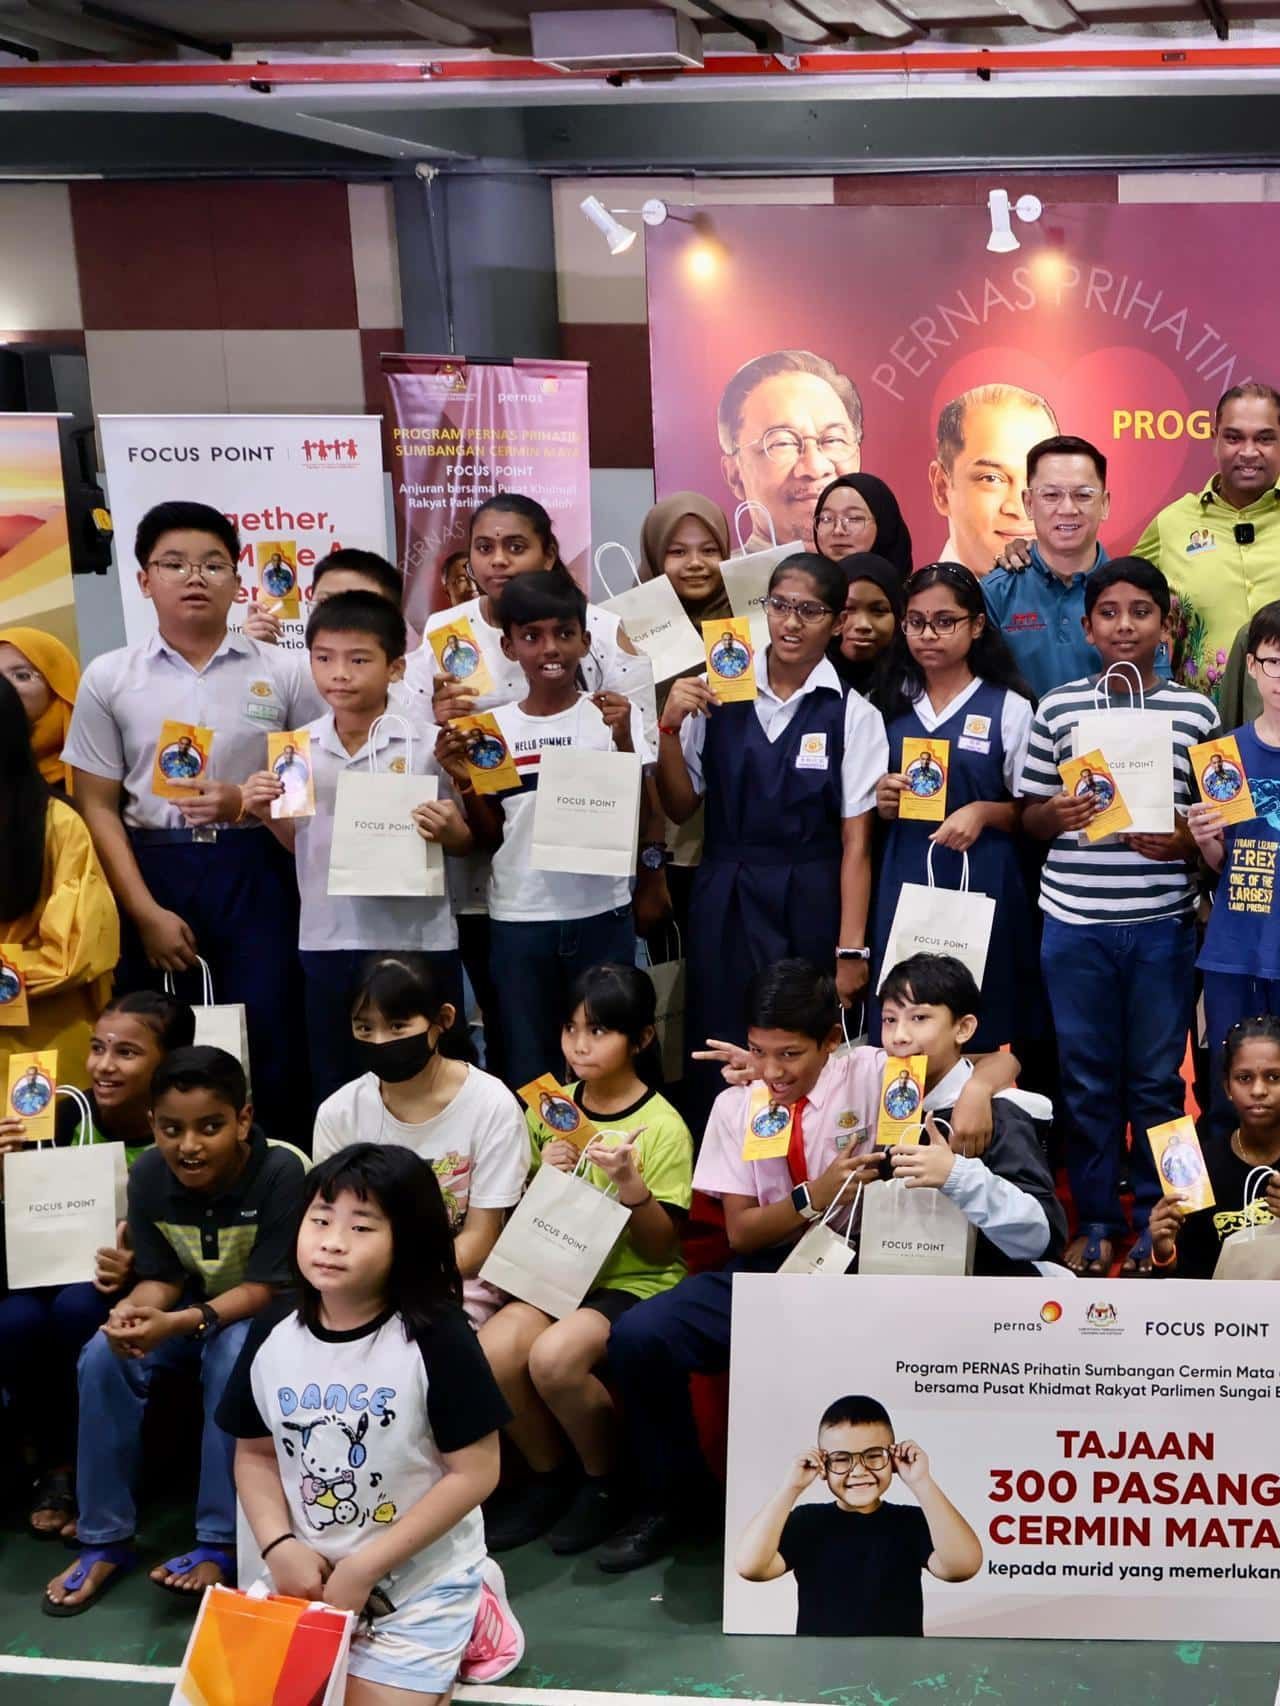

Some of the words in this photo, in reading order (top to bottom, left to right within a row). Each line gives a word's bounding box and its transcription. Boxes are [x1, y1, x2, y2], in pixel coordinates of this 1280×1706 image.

[870, 266, 1036, 402] PERNAS
[1055, 261, 1253, 395] PRIHATIN
[498, 393, 543, 405] pernas
[393, 428, 460, 442] PROGRAM
[468, 428, 517, 442] PERNAS
[128, 447, 200, 463] FOCUS
[211, 446, 276, 463] POINT
[396, 444, 484, 457] SUMBANGAN
[490, 445, 540, 458] CERMIN
[446, 465, 490, 477] FOCUS
[496, 465, 536, 478] POINT
[400, 482, 444, 496] Anjuran
[447, 482, 494, 495] bersama
[408, 498, 447, 512] Rakyat
[649, 621, 673, 637] POINT
[514, 738, 537, 752] HELLO
[1129, 759, 1154, 769] POINT
[557, 795, 586, 807] FOCUS
[590, 798, 617, 809] POINT
[354, 820, 385, 832] FOCUS
[1233, 849, 1277, 869] T-REX
[1230, 873, 1245, 886] ONE
[1248, 874, 1260, 887] OF
[913, 935, 941, 946] FOCUS
[943, 938, 969, 951] POINT
[29, 1201, 63, 1214] FOCUS
[67, 1198, 97, 1211] POINT
[532, 1217, 560, 1238] FOCUS
[562, 1233, 588, 1254] POINT
[881, 1240, 913, 1251] FOCUS
[917, 1242, 945, 1252] POINT
[993, 1320, 1043, 1334] pernas
[1146, 1321, 1206, 1338] FOCUS
[1214, 1322, 1271, 1339] POINT
[896, 1361, 959, 1378] Program
[962, 1361, 1020, 1376] PERNAS
[1023, 1362, 1081, 1377] Prihatin
[1084, 1363, 1176, 1380] Sumbangan
[1179, 1364, 1232, 1379] Cermin
[1236, 1366, 1275, 1380] Mata
[914, 1380, 980, 1396] bersama
[983, 1381, 1025, 1396] Pusat
[1028, 1381, 1092, 1397] Khidmat
[1096, 1382, 1147, 1400] Rakyat
[1151, 1384, 1215, 1399] Parlimen
[1219, 1384, 1271, 1401] Sungai
[277, 1383, 397, 1417] DANCE
[1056, 1430, 1215, 1461] TAJAAN
[987, 1469, 1078, 1504] 300
[988, 1514, 1151, 1547] CERMIN
[987, 1560, 1057, 1580] kepada
[1061, 1561, 1114, 1577] murid
[1118, 1563, 1165, 1582] yang
[1167, 1563, 1280, 1581] memerlukan
